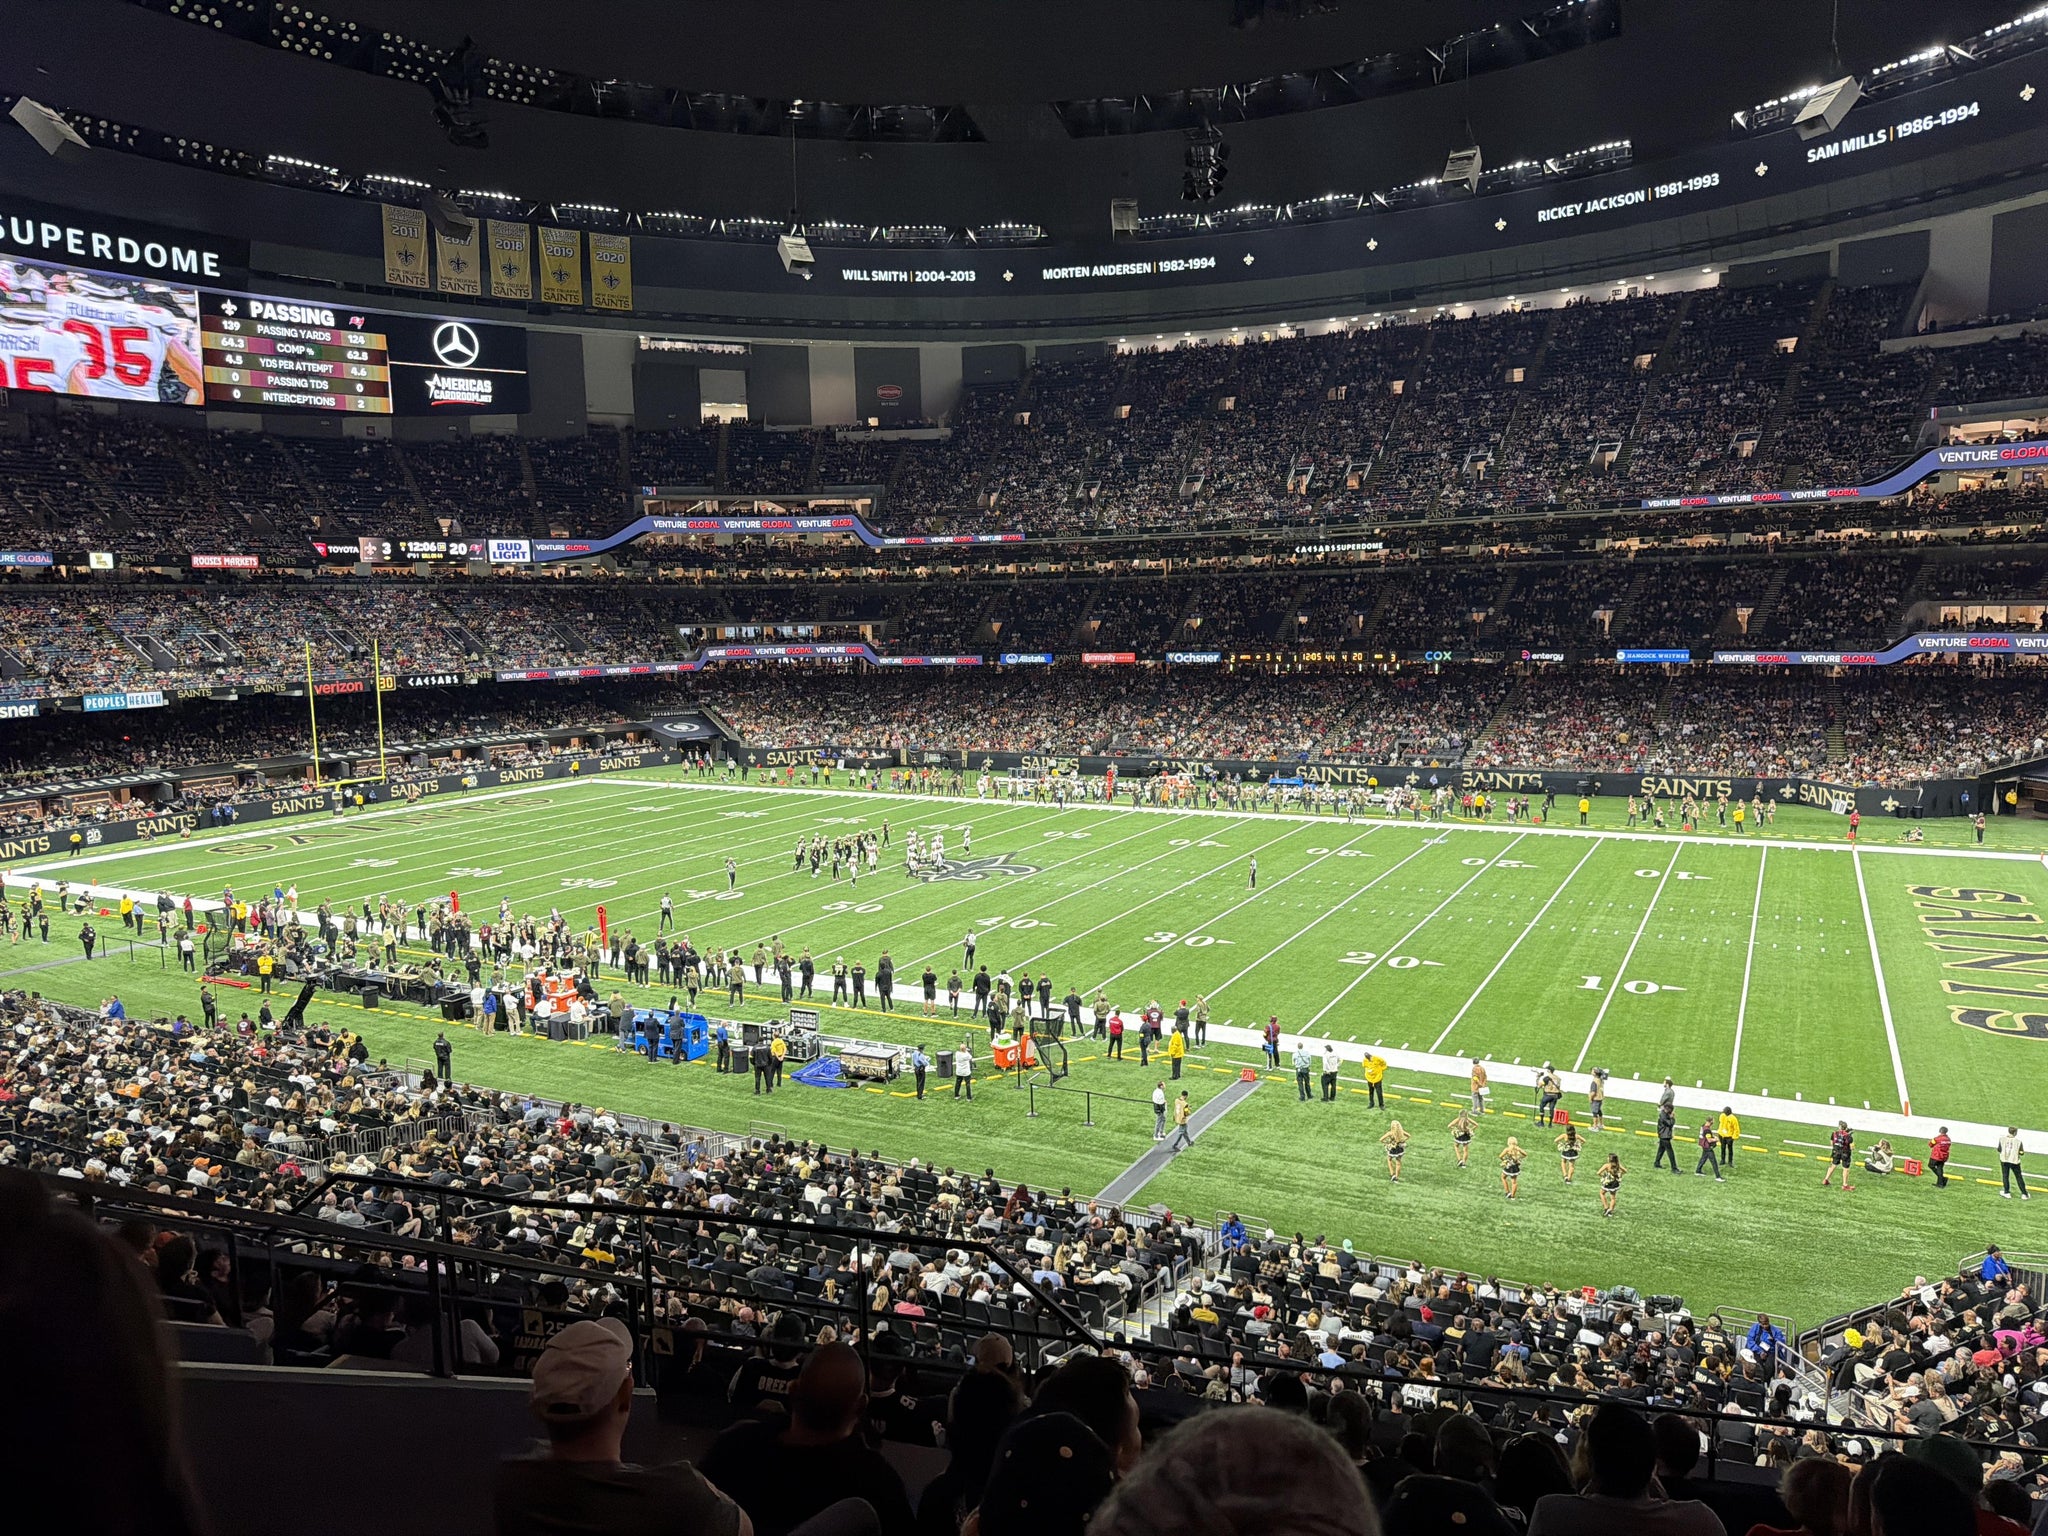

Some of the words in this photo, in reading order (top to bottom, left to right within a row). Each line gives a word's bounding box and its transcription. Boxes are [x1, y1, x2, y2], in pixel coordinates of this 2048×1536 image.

[1807, 143, 1841, 163] SAM
[1842, 128, 1888, 155] MILLS
[1896, 101, 1980, 139] 1986-1994
[1537, 202, 1583, 223] RICKEY
[1584, 189, 1646, 215] JACKSON
[1654, 173, 1720, 199] 1981-1993
[391, 224, 419, 239] 2011
[495, 238, 524, 251] 2018
[546, 245, 574, 258] 2019
[595, 251, 625, 263] 2020
[1042, 267, 1090, 280] MORTEN
[1092, 262, 1152, 278] ANDERSEN
[1158, 256, 1217, 273] 1982-1994
[388, 272, 426, 287] SAINTS
[842, 269, 870, 282] WILL
[871, 269, 909, 283] SMITH
[914, 270, 976, 282] 2004-2013
[440, 280, 478, 294] SAINTS
[493, 285, 530, 298] SAINTS
[543, 290, 580, 305] SAINTS
[594, 295, 630, 309] SAINTS
[250, 301, 335, 327] PASSING
[222, 319, 241, 331] 139
[257, 324, 298, 338] PASSING
[299, 328, 331, 342] YARDS
[221, 336, 245, 348] 64.3
[347, 334, 365, 345] 124
[276, 343, 306, 355] COMP
[259, 357, 278, 369] YDS
[278, 359, 295, 370] PER
[295, 361, 333, 374] ATTEMPT
[350, 366, 368, 377] 4.6
[231, 371, 240, 382] 0
[267, 375, 308, 388] PASSING
[310, 378, 329, 390] TDS
[355, 383, 364, 393] 0
[425, 373, 492, 393] AMERICAS
[262, 391, 336, 406] INTERCEPTIONS
[357, 399, 366, 409] 2
[1939, 450, 1998, 463] VENTURE
[1718, 494, 1751, 503] VENTURE
[1752, 493, 1781, 501] GLOBAL
[1791, 490, 1827, 499] VENTURE
[1827, 488, 1859, 497] GLOBAL
[1566, 502, 1600, 511] SAINTS
[1648, 499, 1680, 507] VENTURE
[1680, 497, 1709, 506] GLOBAL
[1425, 510, 1455, 520] SAINTS
[1494, 506, 1526, 515] SAINTS
[653, 520, 687, 529] VENTURE
[687, 520, 720, 529] GLOBAL
[724, 520, 761, 529] VENTURE
[761, 520, 793, 529] GLOBAL
[796, 519, 831, 528] VENTURE
[831, 518, 853, 527] GLOBAL
[1358, 514, 1388, 523] SAINTS
[327, 546, 359, 554] TOYOTA
[382, 542, 392, 555] 3
[408, 541, 436, 552] 12:06
[450, 543, 467, 556] 20
[496, 541, 522, 551] BUD
[536, 543, 566, 551] VENTURE
[1295, 545, 1336, 554] CAESARS
[1336, 542, 1383, 551] SUPERDOME
[16, 554, 51, 563] GLOBAL
[120, 554, 155, 562] SAINTS
[266, 556, 297, 564] SAINTS
[492, 550, 527, 560] LIGHT
[193, 557, 222, 566] ROUSES
[223, 557, 258, 567] MARKETS
[1918, 638, 1967, 647] VENTURE
[1969, 637, 2010, 647] GLOBAL
[727, 648, 752, 656] GLOBAL
[755, 647, 786, 655] VENTURE
[786, 646, 812, 655] GLOBAL
[816, 646, 845, 654] VENTURE
[1425, 651, 1452, 661] COX
[1018, 654, 1046, 662] Allstate
[1175, 653, 1218, 662] Ochsner
[1302, 653, 1322, 661] 12:05
[1352, 653, 1363, 661] 20
[1531, 652, 1564, 662] entergy
[1718, 654, 1756, 662] VENTURE
[1756, 654, 1788, 663] GLOBAL
[1801, 654, 1840, 663] VENTURE
[1841, 655, 1876, 664] GLOBAL
[554, 669, 579, 677] VENTURE
[655, 664, 678, 672] VENTURE
[408, 675, 459, 688] CAESARS
[464, 671, 492, 680] SAINTS
[501, 672, 527, 680] VENTURE
[527, 671, 549, 679] GLOBAL
[177, 687, 212, 698] SAINTS
[254, 683, 286, 693] SAINTS
[313, 679, 364, 696] verizon
[86, 696, 125, 709] PEOPLES
[128, 694, 162, 706] HEALTH
[426, 731, 549, 750] SUPERDOME
[600, 756, 640, 771] SAINTS
[499, 767, 545, 783] SAINTS
[1296, 765, 1369, 784] SAINTS
[6, 769, 181, 797] SUPERDOME
[390, 779, 439, 798] SAINTS
[1641, 776, 1732, 798] SAINTS
[1800, 783, 1856, 810] SAINTS
[271, 794, 325, 815] SAINTS
[136, 813, 197, 839] SAINTS
[821, 900, 884, 914] 50
[974, 915, 1040, 930] 40
[1143, 931, 1217, 948] 30
[1338, 950, 1421, 970] 20
[1576, 975, 1660, 995] 10
[1006, 1050, 1015, 1061] G
[859, 1066, 887, 1078] SAINTS
[1907, 1161, 1918, 1174] G
